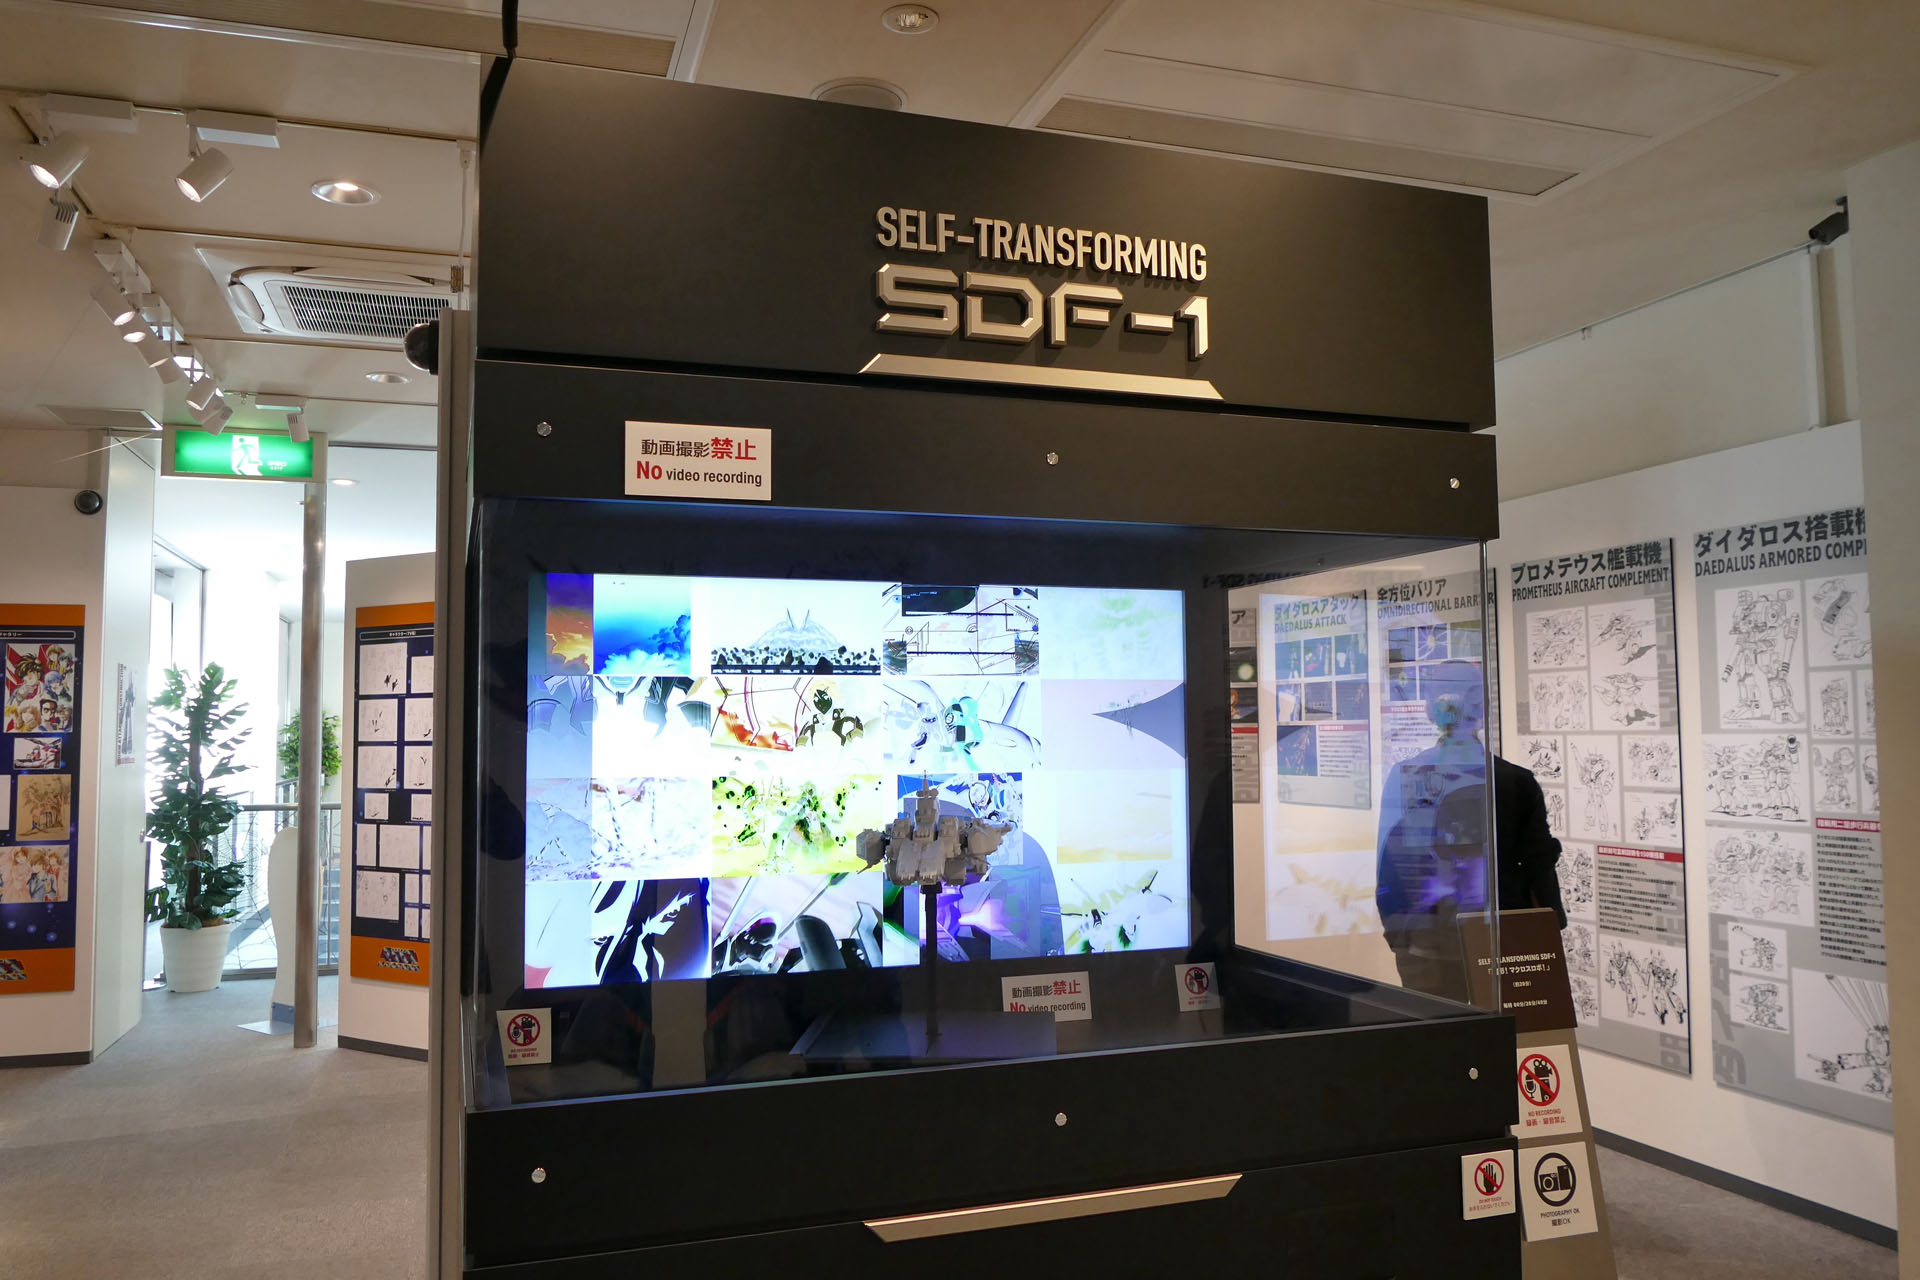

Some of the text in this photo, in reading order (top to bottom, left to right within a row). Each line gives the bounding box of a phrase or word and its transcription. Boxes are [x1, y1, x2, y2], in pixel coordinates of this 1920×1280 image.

[875, 206, 1207, 282] SELF-TRANSFORMING
[876, 263, 1208, 359] SDF-1
[641, 437, 757, 461] 動画撮影禁止
[636, 461, 762, 487] No video recording
[1512, 541, 1662, 585] プロメテウス艦載機
[1695, 554, 1756, 577] DAEDALUS
[1759, 547, 1822, 569] ARMORED
[1377, 578, 1447, 604] 全方位バリア
[1512, 567, 1670, 602] PROMETHEUS AIRCRAFT COMPLEMENT
[1274, 592, 1360, 622] ダイダロスアタック
[1377, 592, 1496, 619] OMNIDIRECTIONAL BARRR
[1274, 613, 1347, 634] DAEDALUS ATTACK
[1478, 953, 1540, 966] SELFTANSFORMING
[1012, 979, 1081, 999] 動画撮影禁止
[1010, 1001, 1086, 1013] No video recording
[1540, 1208, 1572, 1219] PHOTOGRAPHY
